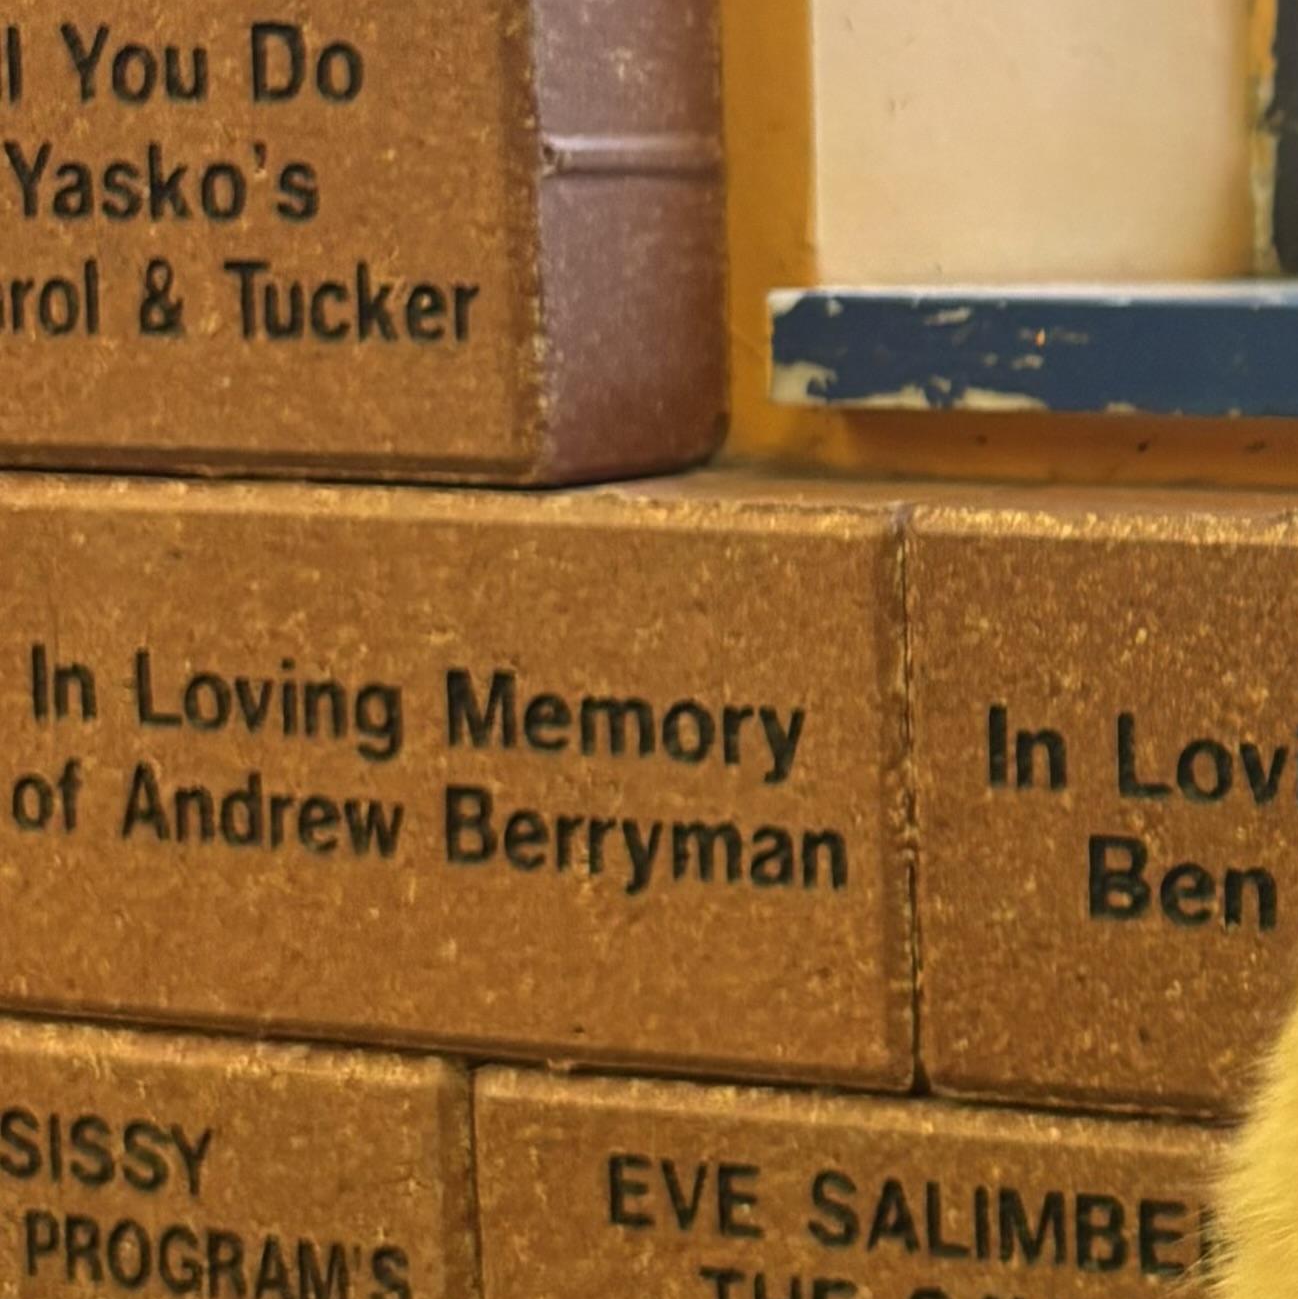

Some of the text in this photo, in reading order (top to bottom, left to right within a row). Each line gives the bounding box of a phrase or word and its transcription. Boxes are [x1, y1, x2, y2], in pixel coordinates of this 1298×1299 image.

[60, 23, 207, 105] You
[250, 21, 363, 103] Do
[3, 141, 318, 223] Yasko's
[0, 257, 479, 342] rol & Tucker
[31, 644, 804, 785] In Loving Memory
[988, 705, 1066, 791] In
[11, 760, 847, 896] of Andrew Berryman
[1089, 835, 1276, 931] Ben
[0, 1108, 213, 1198] SISSY
[608, 1154, 762, 1239] EVE
